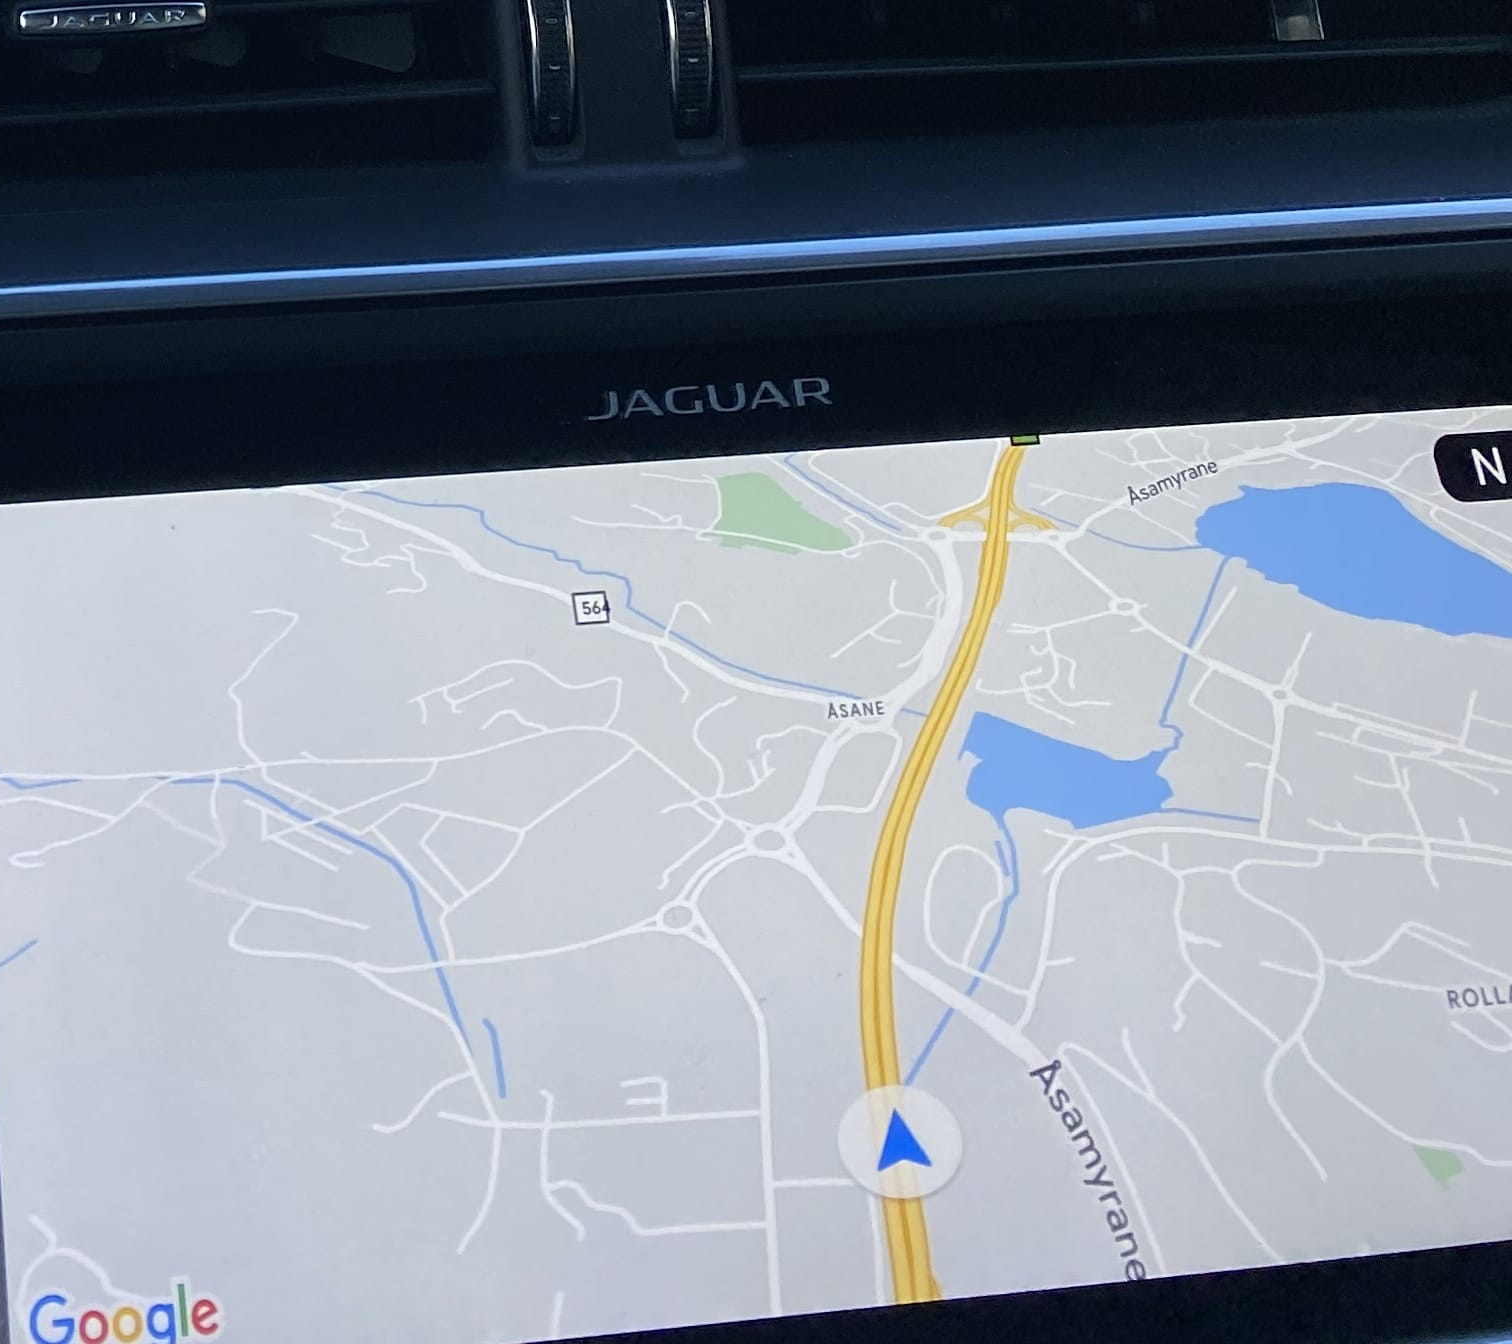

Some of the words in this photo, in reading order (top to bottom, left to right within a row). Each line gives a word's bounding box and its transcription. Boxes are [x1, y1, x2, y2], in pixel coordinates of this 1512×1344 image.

[41, 9, 186, 29] JAGUAR
[584, 376, 833, 421] JAGUAR
[1126, 460, 1219, 506] Åsamyrane
[1470, 446, 1508, 486] N
[581, 600, 611, 616] 564
[1446, 984, 1512, 1009] ROLL
[1028, 1058, 1147, 1282] Åsamyrane
[29, 1283, 219, 1344] Google
